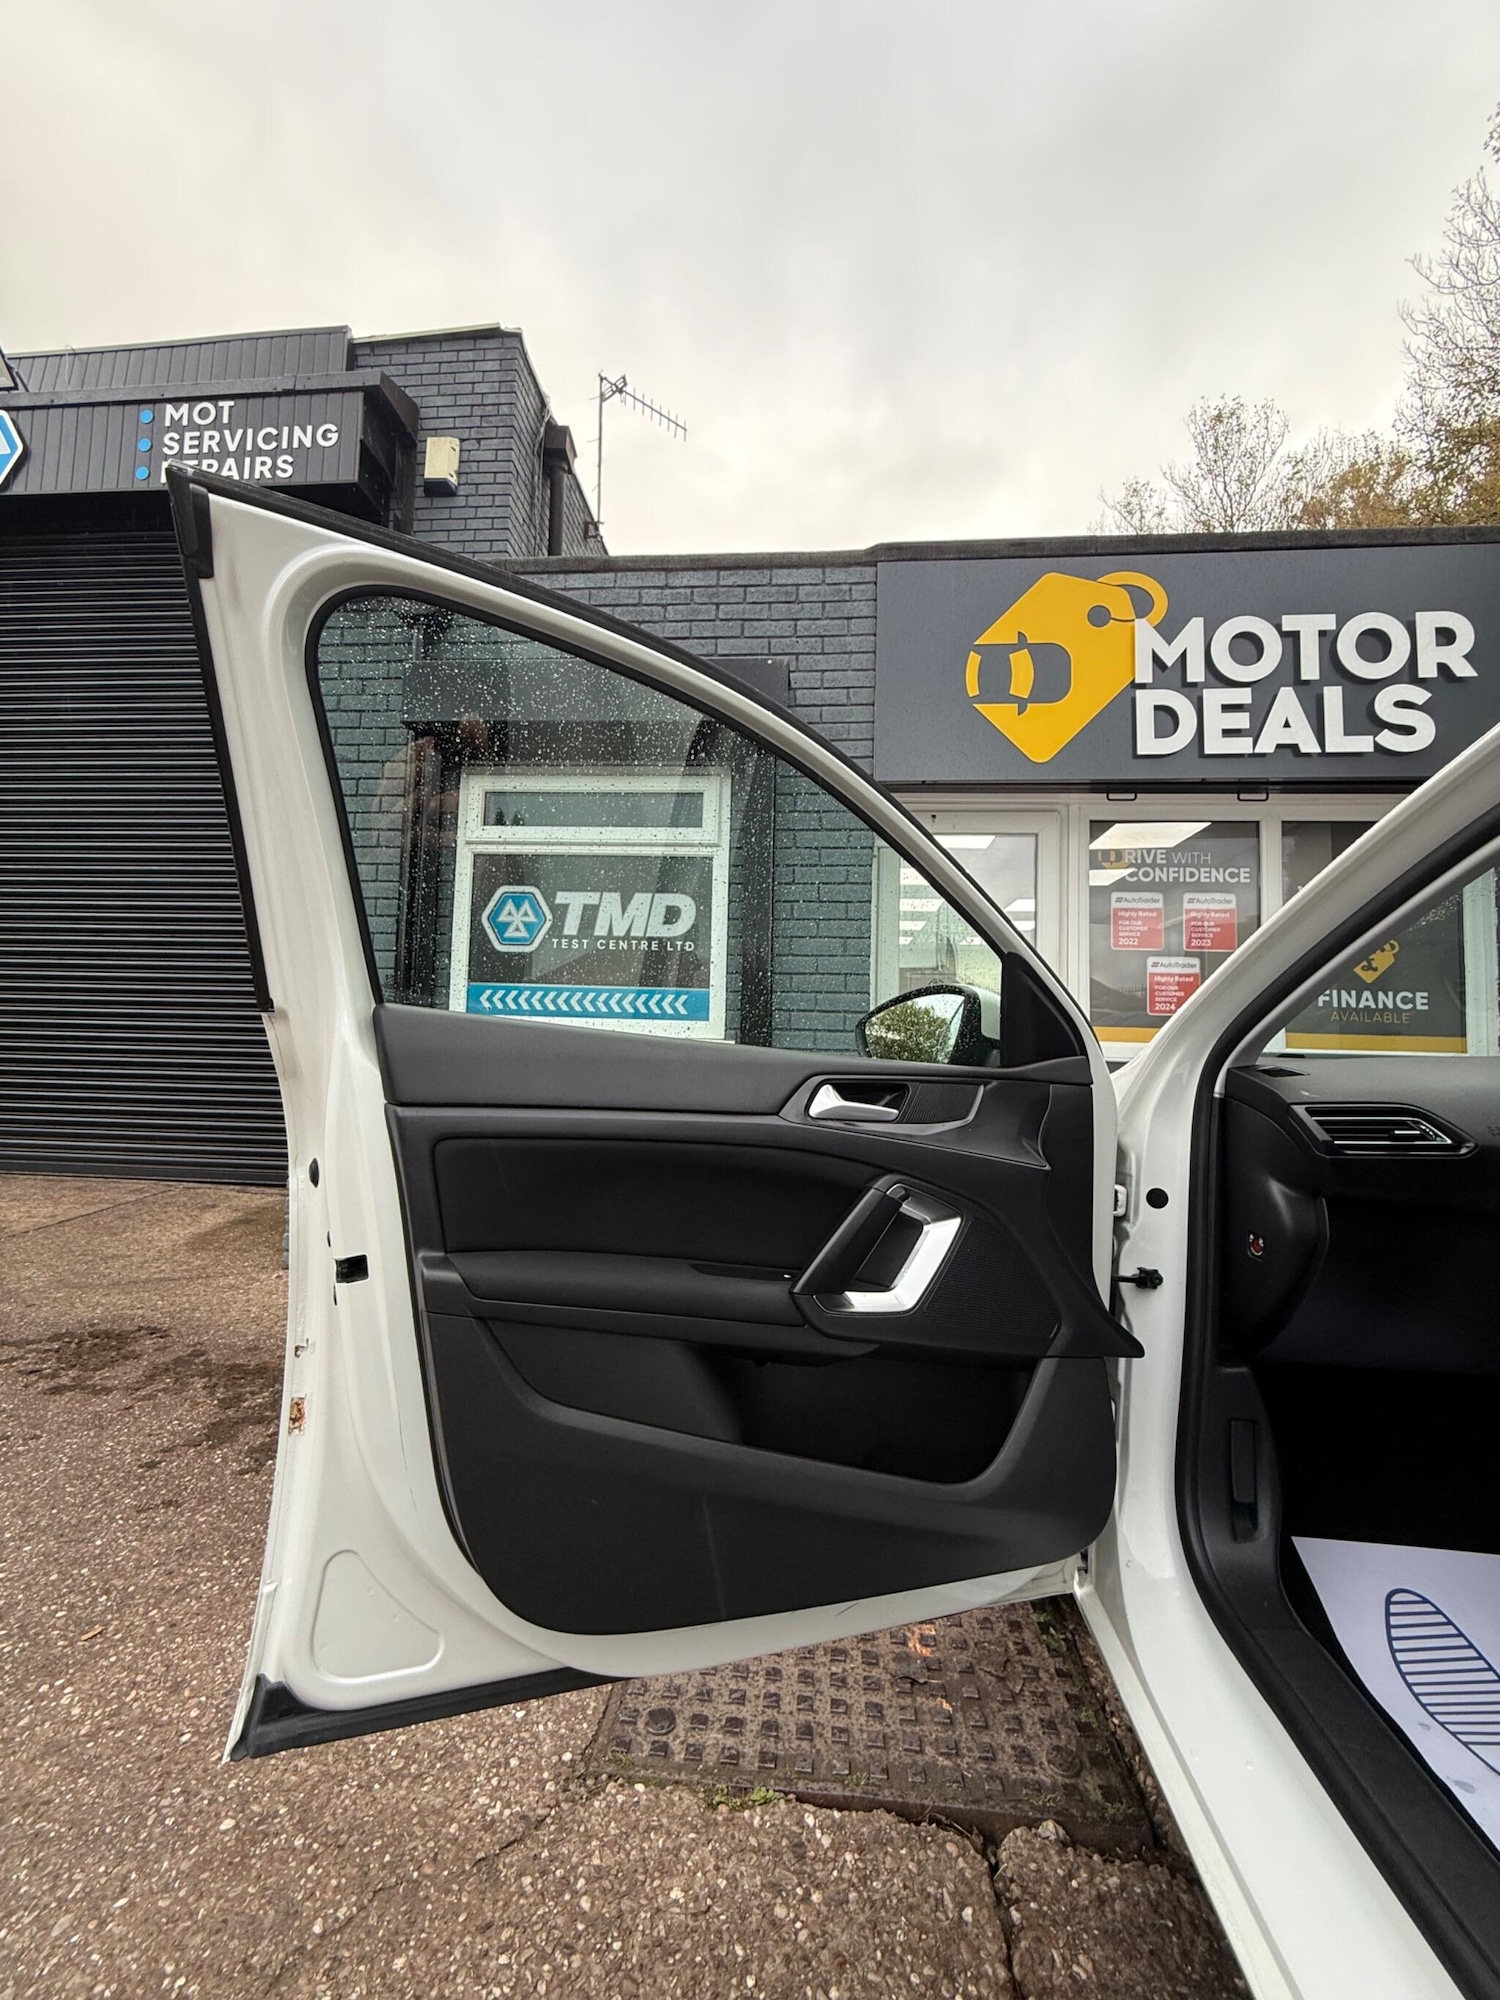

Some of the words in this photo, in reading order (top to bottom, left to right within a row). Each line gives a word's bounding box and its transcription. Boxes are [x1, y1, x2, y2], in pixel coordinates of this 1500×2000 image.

[164, 401, 234, 427] MOT
[162, 423, 339, 456] SERVICING
[160, 454, 294, 483] PAIRS
[1134, 611, 1478, 684] MOTOR
[1135, 684, 1437, 755] DEALS
[1172, 852, 1212, 864] WITH
[1125, 867, 1250, 883] CONFIDENCE
[555, 891, 696, 937] TMD
[552, 939, 589, 949] TEST
[597, 940, 659, 951] CENTRE
[667, 941, 695, 951] LTD
[1317, 989, 1429, 1010] FINANCE
[1330, 1011, 1410, 1023] AVAILABLE
